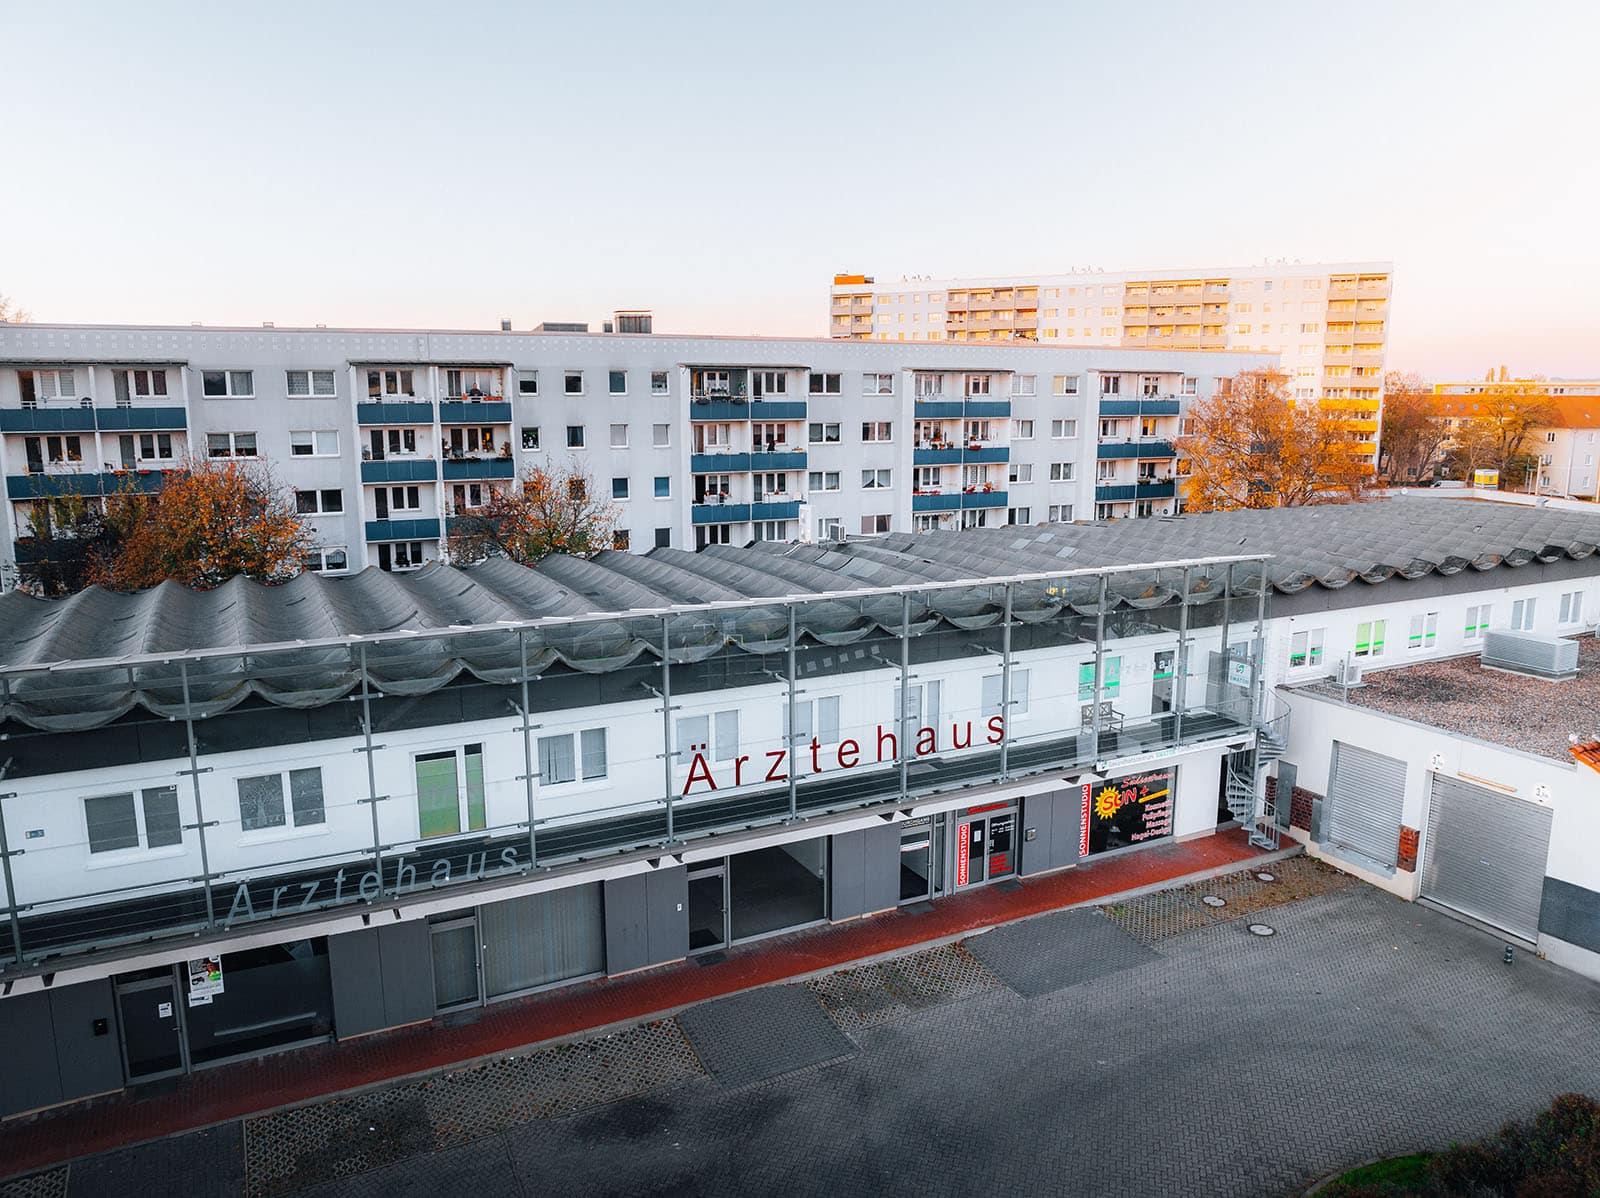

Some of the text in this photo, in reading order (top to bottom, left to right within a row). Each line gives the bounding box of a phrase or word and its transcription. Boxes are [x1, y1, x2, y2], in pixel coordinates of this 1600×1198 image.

[682, 716, 1005, 795] Ärztehaus
[1079, 784, 1089, 856] SONNENSTUDIO
[1102, 787, 1137, 811] SUN
[959, 824, 968, 885] SONNENSTUDIO
